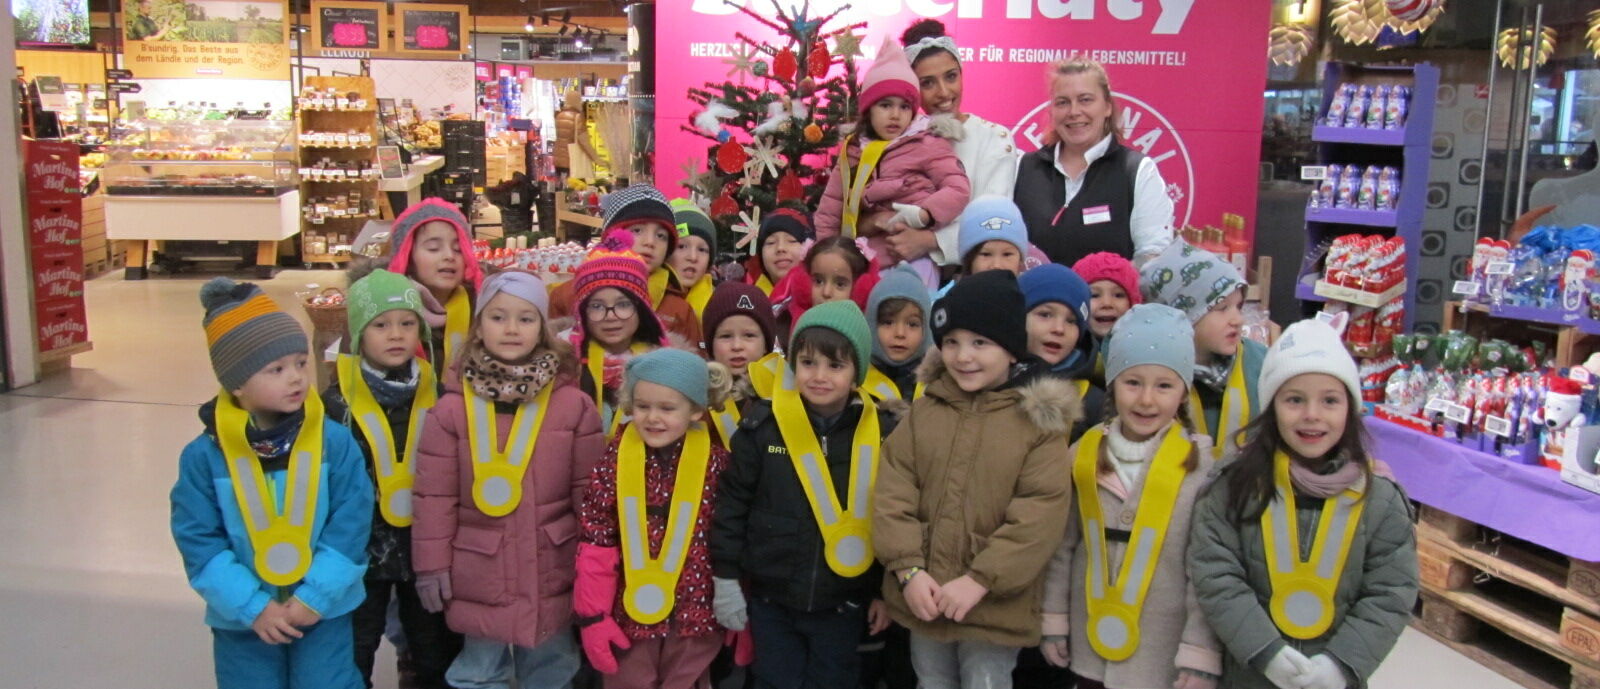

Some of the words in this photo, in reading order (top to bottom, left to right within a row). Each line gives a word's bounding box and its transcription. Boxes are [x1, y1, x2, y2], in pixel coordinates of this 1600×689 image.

[200, 44, 222, 53] Beste
[979, 46, 1004, 63] FÜR
[135, 54, 153, 62] dem
[156, 54, 182, 63] Ländle
[184, 55, 199, 63] und
[202, 55, 214, 63] der
[33, 160, 78, 180] Martins
[43, 175, 66, 192] Hof
[33, 213, 80, 233] Martins
[44, 227, 68, 244] Hof
[38, 266, 81, 287] Martins
[48, 280, 71, 297] Hof
[736, 294, 755, 310] A
[40, 318, 84, 341] Martins
[768, 445, 787, 455] BAT
